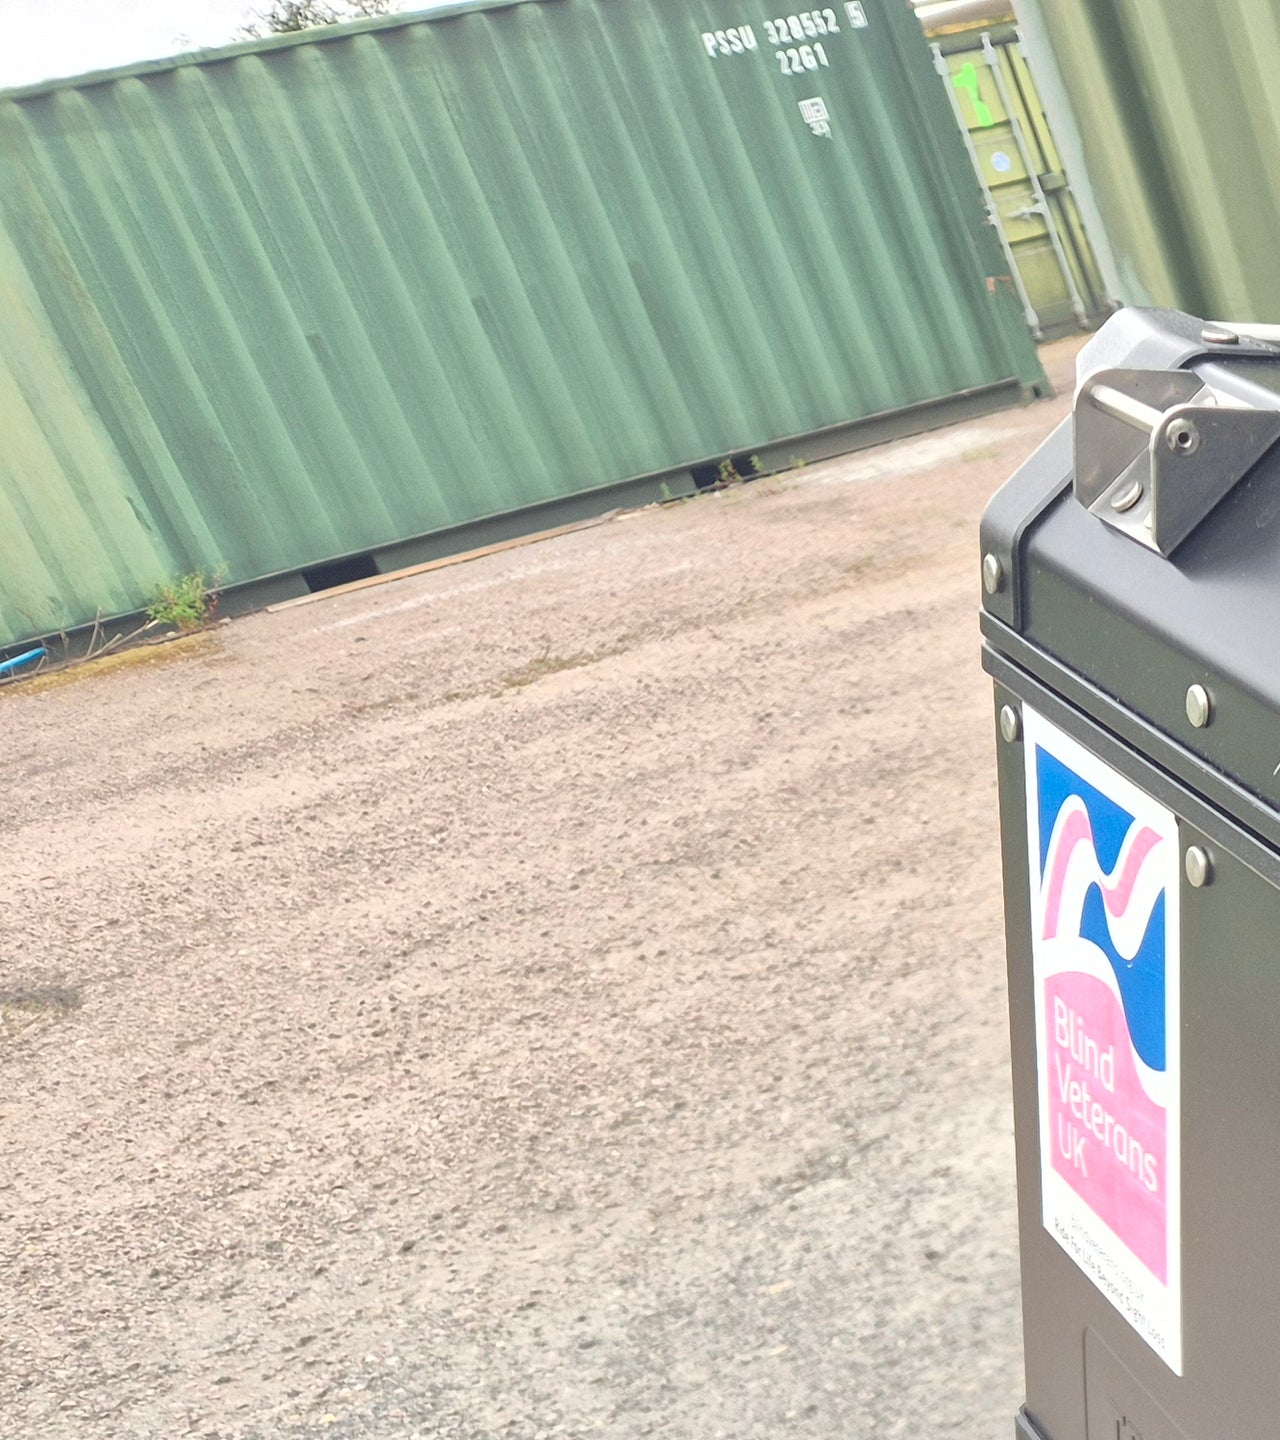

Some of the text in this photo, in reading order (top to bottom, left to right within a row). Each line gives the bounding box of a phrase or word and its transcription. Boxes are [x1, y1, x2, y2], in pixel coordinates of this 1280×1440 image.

[701, 25, 758, 58] PSSU
[763, 8, 840, 46] 328552
[1054, 994, 1115, 1094] Blind
[1055, 1051, 1159, 1193] Veterans
[1057, 1111, 1089, 1178] UK
